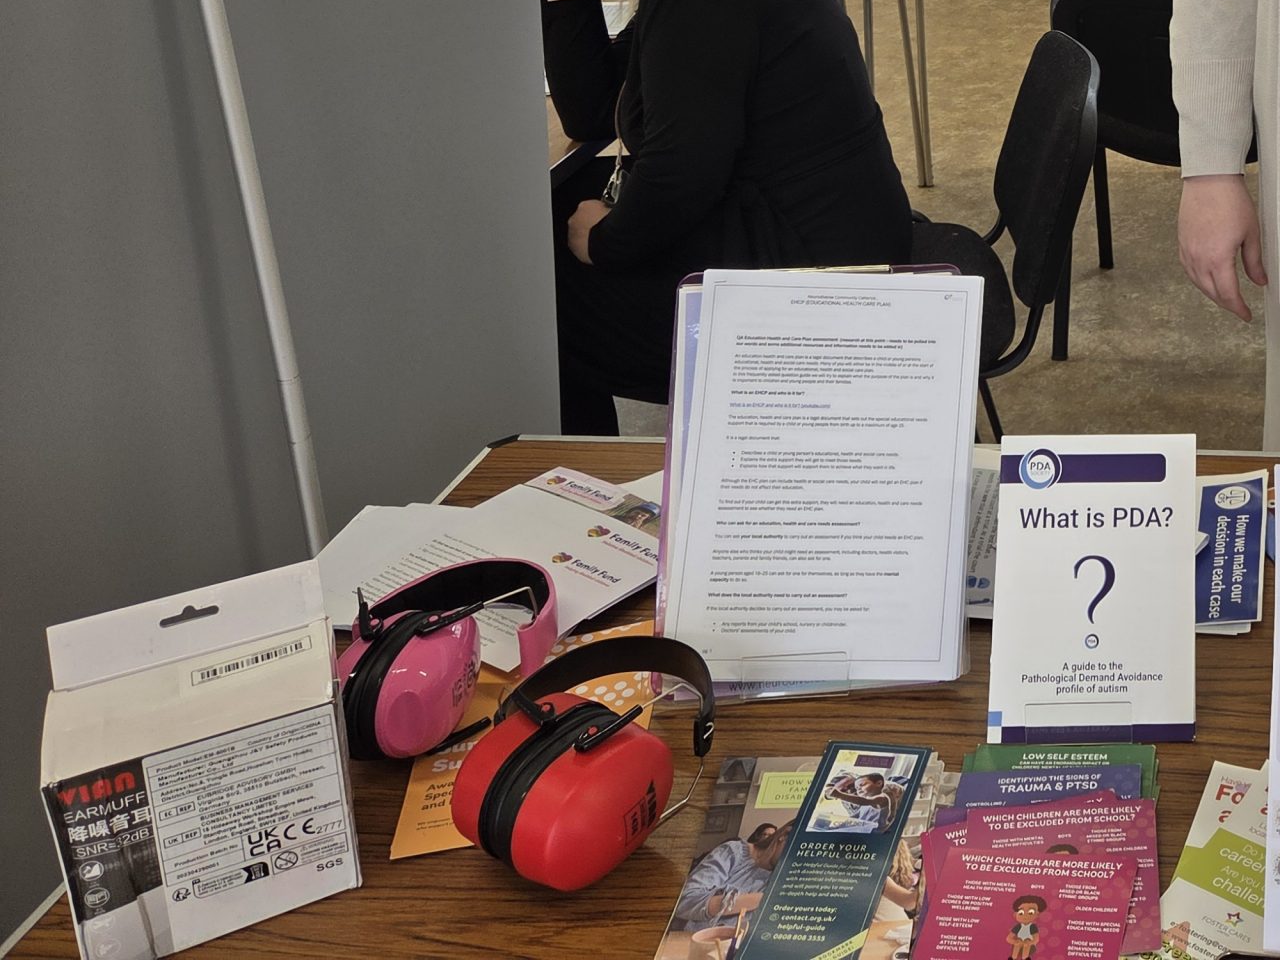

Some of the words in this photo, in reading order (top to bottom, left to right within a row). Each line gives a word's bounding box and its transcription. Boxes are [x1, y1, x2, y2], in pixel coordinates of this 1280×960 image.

[1030, 461, 1051, 472] PDA
[1019, 508, 1078, 529] What
[1086, 508, 1105, 528] is
[1113, 507, 1174, 528] PDA?
[1235, 514, 1249, 535] How
[1214, 516, 1229, 555] decision
[1233, 537, 1245, 553] we
[1213, 558, 1224, 566] in
[1231, 555, 1246, 582] make
[571, 560, 599, 574] Family
[598, 570, 621, 583] Fund
[1211, 568, 1226, 594] each
[1230, 584, 1243, 604] our
[1209, 596, 1222, 619] case
[1062, 662, 1069, 671] A
[1071, 662, 1096, 673] guide
[1098, 662, 1107, 671] to
[1108, 661, 1123, 671] the
[1021, 673, 1077, 684] Pathological
[1079, 673, 1115, 683] Demand
[1117, 672, 1163, 682] Avoidance
[1056, 684, 1085, 695] profile
[1086, 684, 1096, 694] of
[1098, 683, 1128, 694] autism
[1000, 784, 1051, 793] TRAUMA
[1055, 783, 1063, 791] &
[1066, 781, 1098, 790] PTSD
[64, 791, 145, 823] EARMUFF
[248, 826, 279, 844] UK
[316, 820, 342, 834] 2777
[250, 839, 281, 857] CA
[797, 850, 840, 859] HELPFUL
[845, 852, 877, 860] GUIDE
[800, 843, 835, 851] ORDER
[839, 844, 867, 852] YOUR
[317, 858, 344, 872] SGS
[962, 854, 993, 863] WHICH
[995, 856, 1041, 866] CHILDREN
[1042, 858, 1061, 868] ARE
[1062, 859, 1089, 869] MORE
[1090, 861, 1122, 870] LIKELY
[965, 862, 977, 870] TO
[979, 863, 992, 871] BE
[993, 864, 1041, 875] EXCLUDED
[1042, 867, 1070, 877] FROM
[1071, 868, 1114, 879] SCHOOL?
